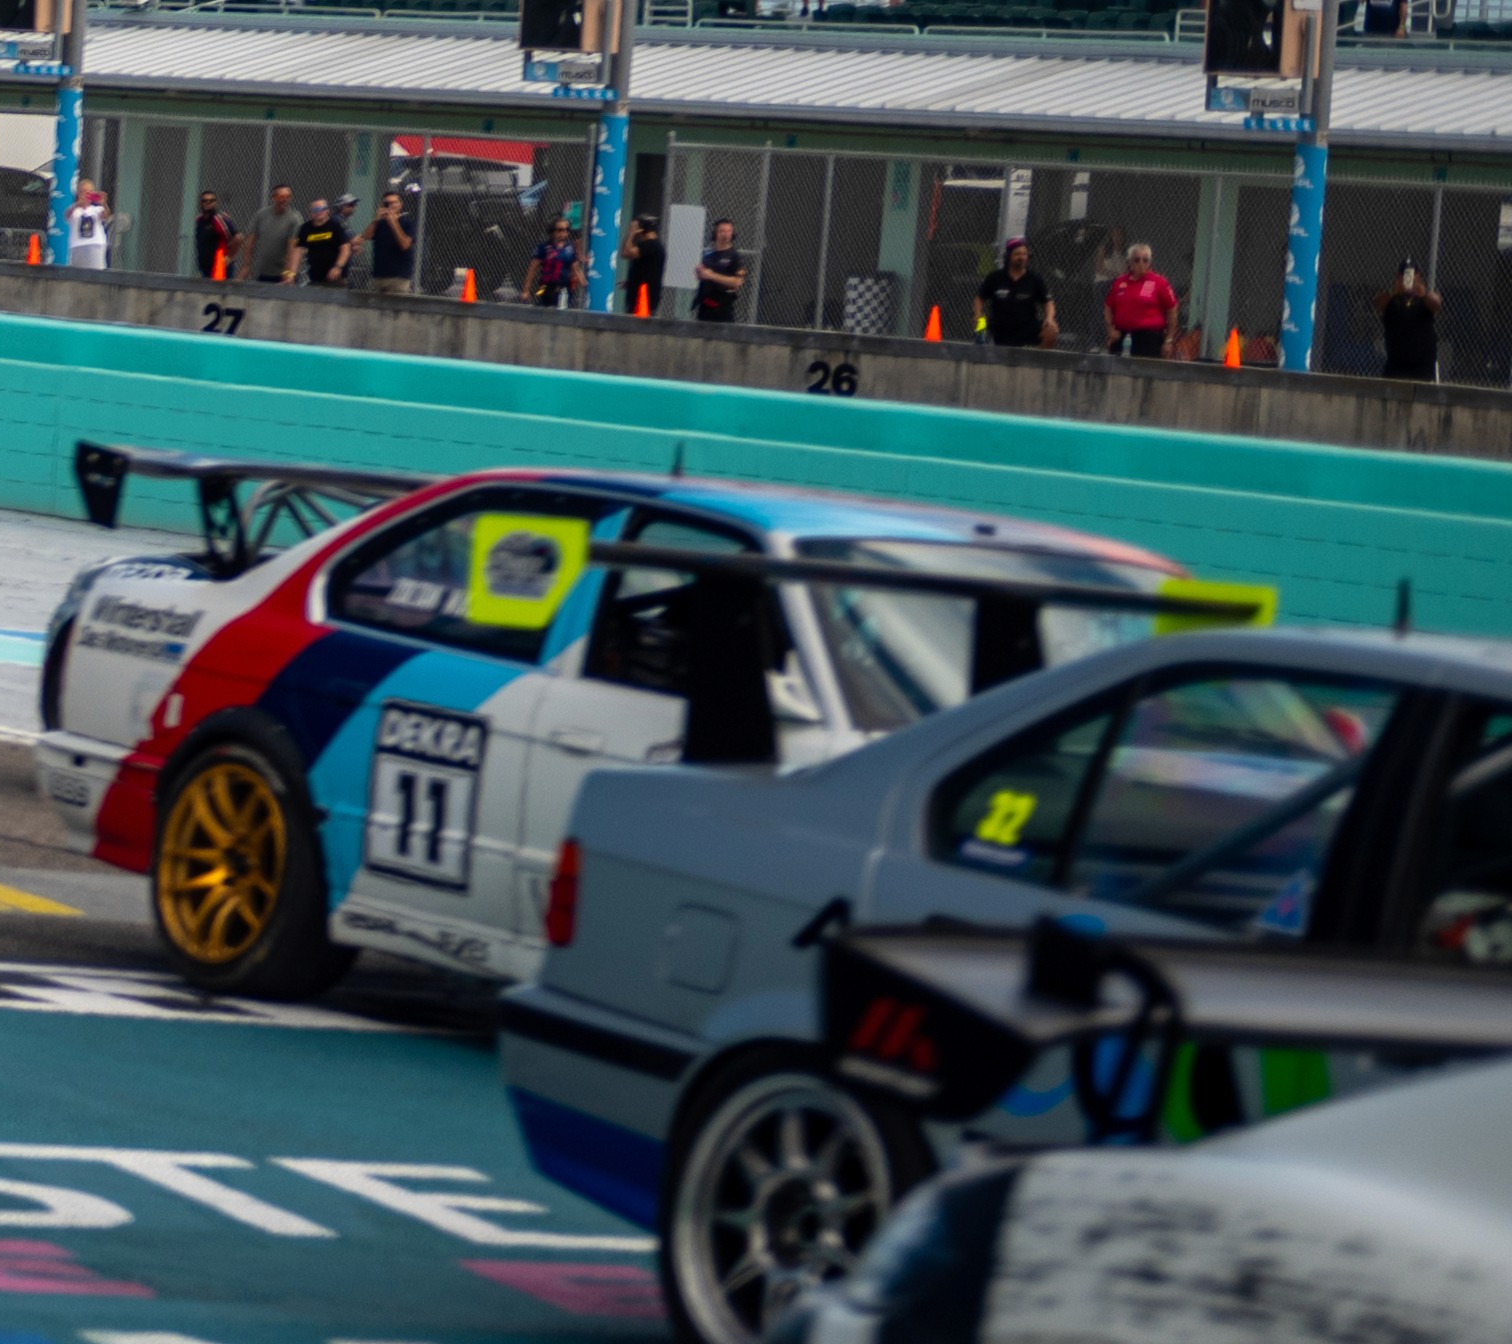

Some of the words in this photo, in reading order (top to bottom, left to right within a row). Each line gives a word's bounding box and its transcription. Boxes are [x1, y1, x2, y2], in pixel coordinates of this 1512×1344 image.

[202, 303, 246, 336] 27
[807, 361, 858, 397] 26
[380, 707, 480, 767] DEKRA
[394, 772, 449, 865] 11
